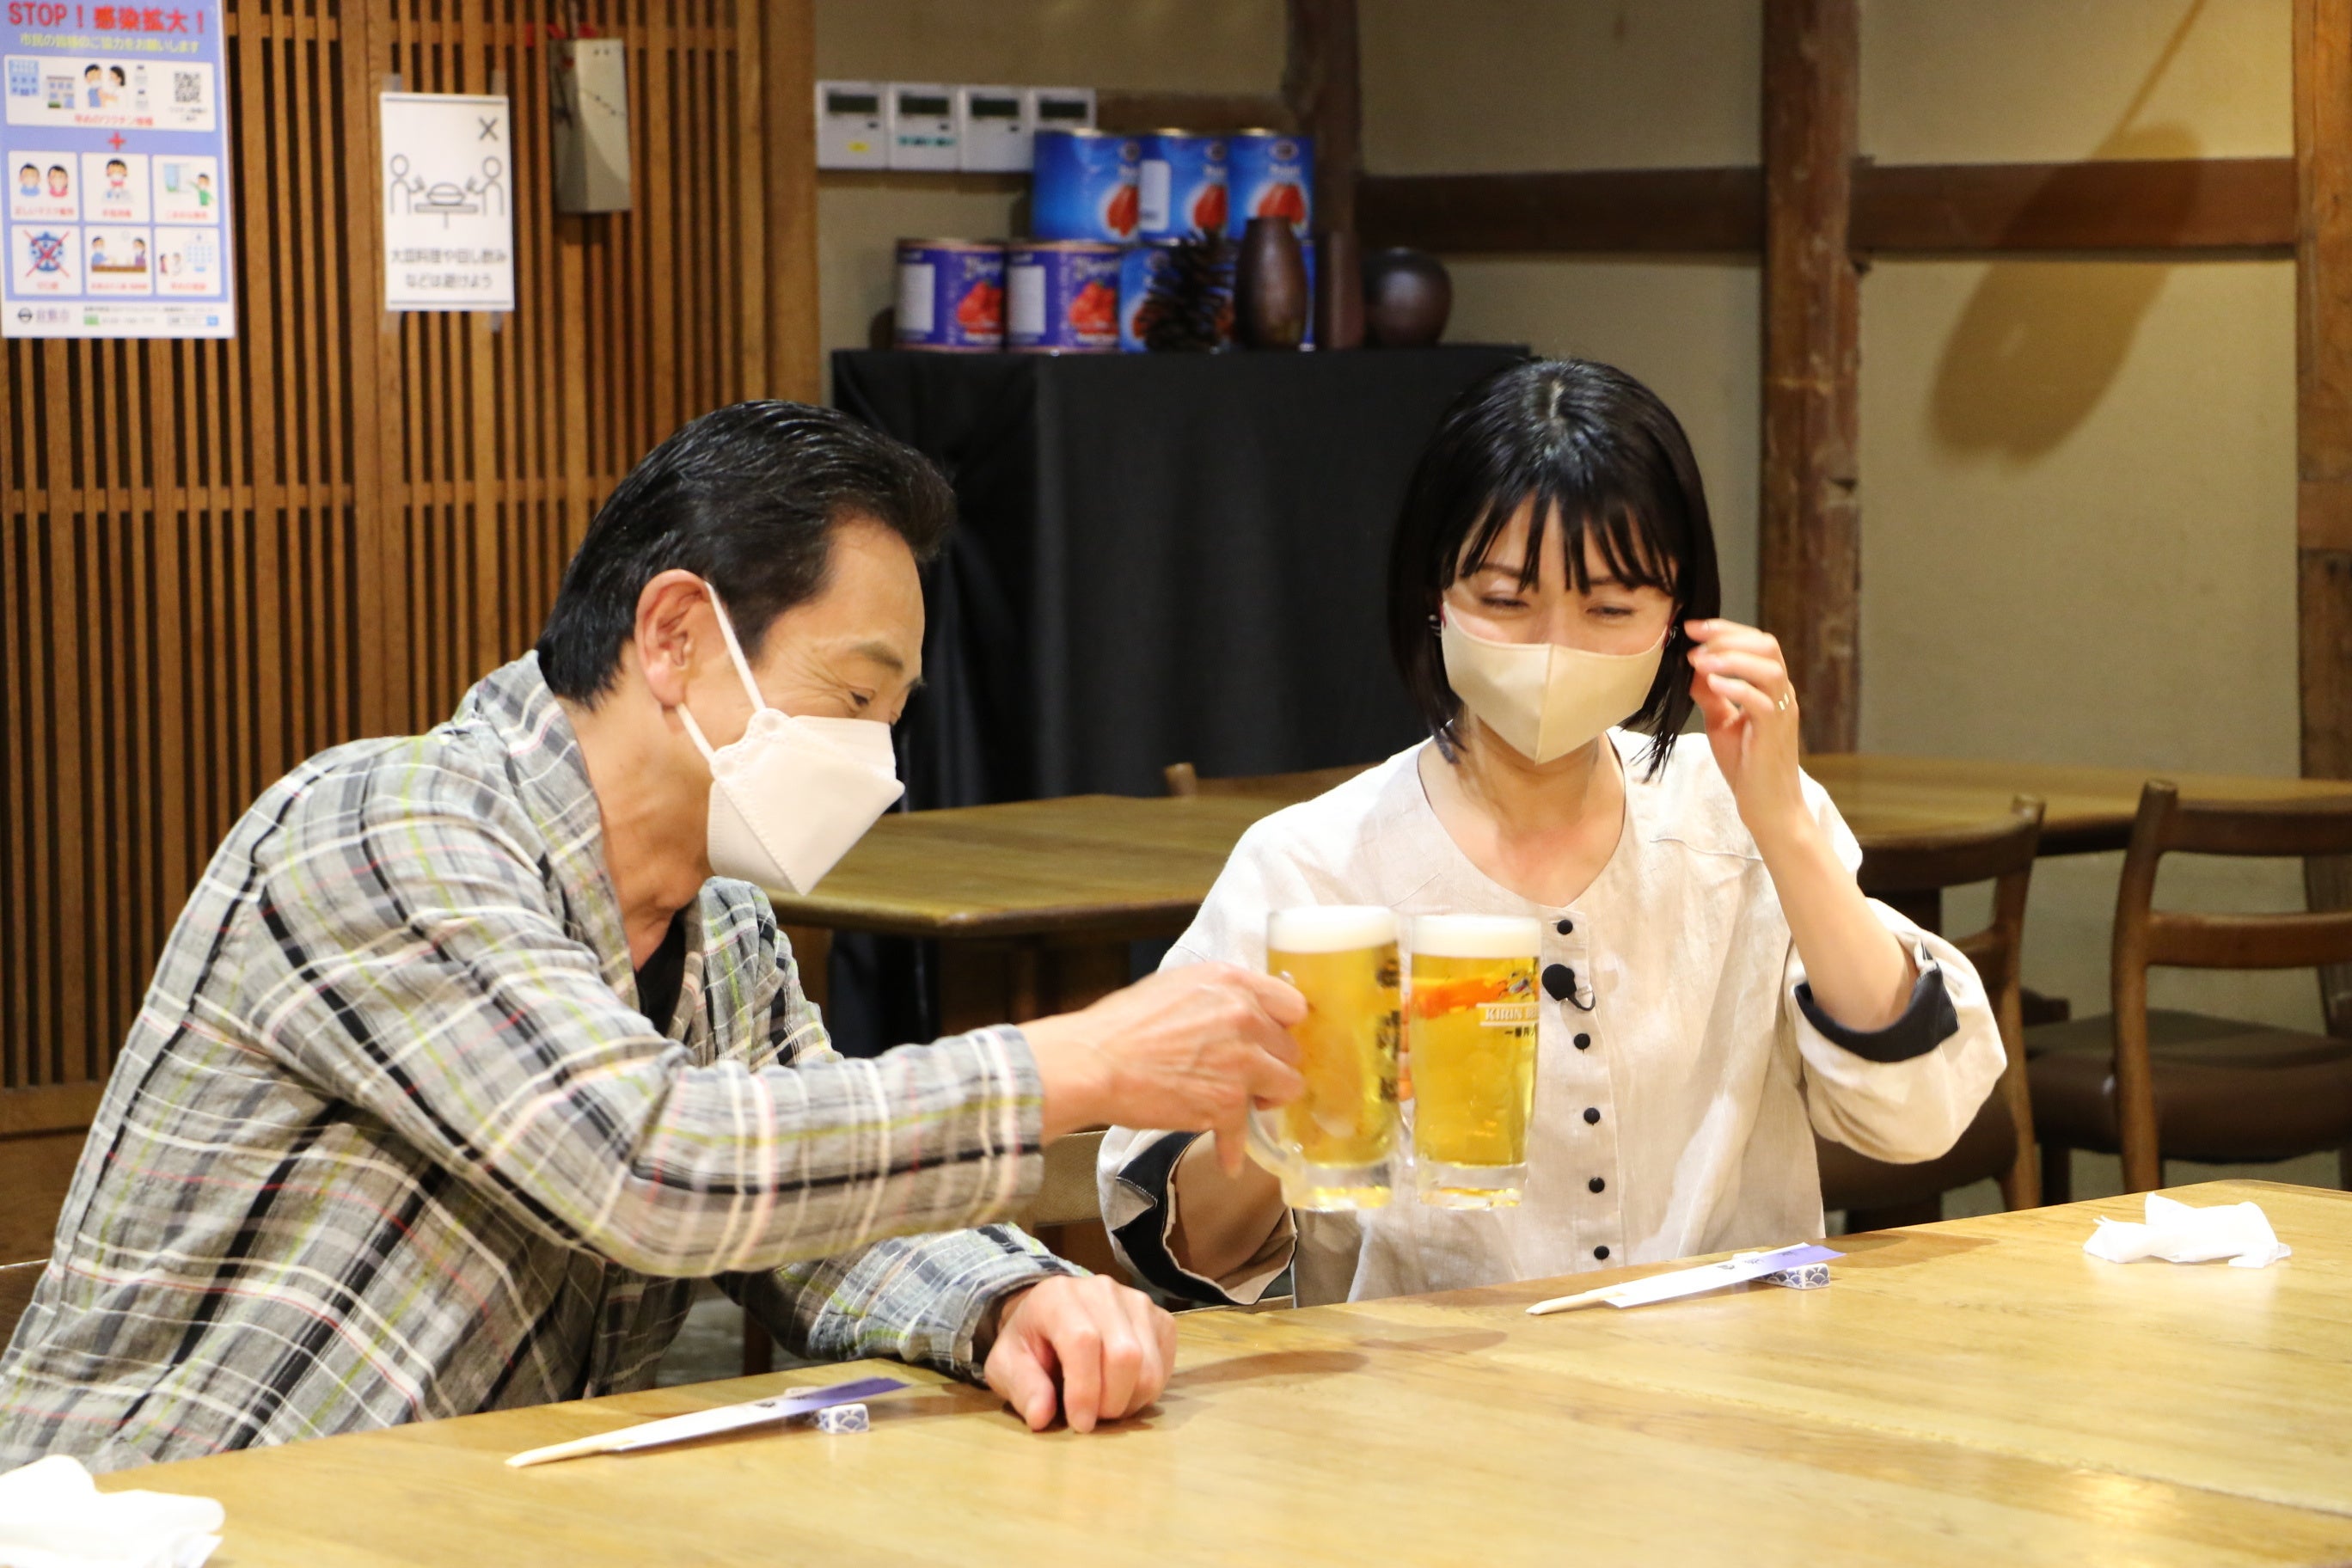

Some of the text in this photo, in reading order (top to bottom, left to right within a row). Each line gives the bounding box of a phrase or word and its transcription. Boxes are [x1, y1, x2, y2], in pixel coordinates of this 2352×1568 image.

[391, 248, 506, 264] 大皿料理や回し飲み
[405, 273, 493, 290] などは避けよう
[1485, 1008, 1522, 1021] KIRIN
